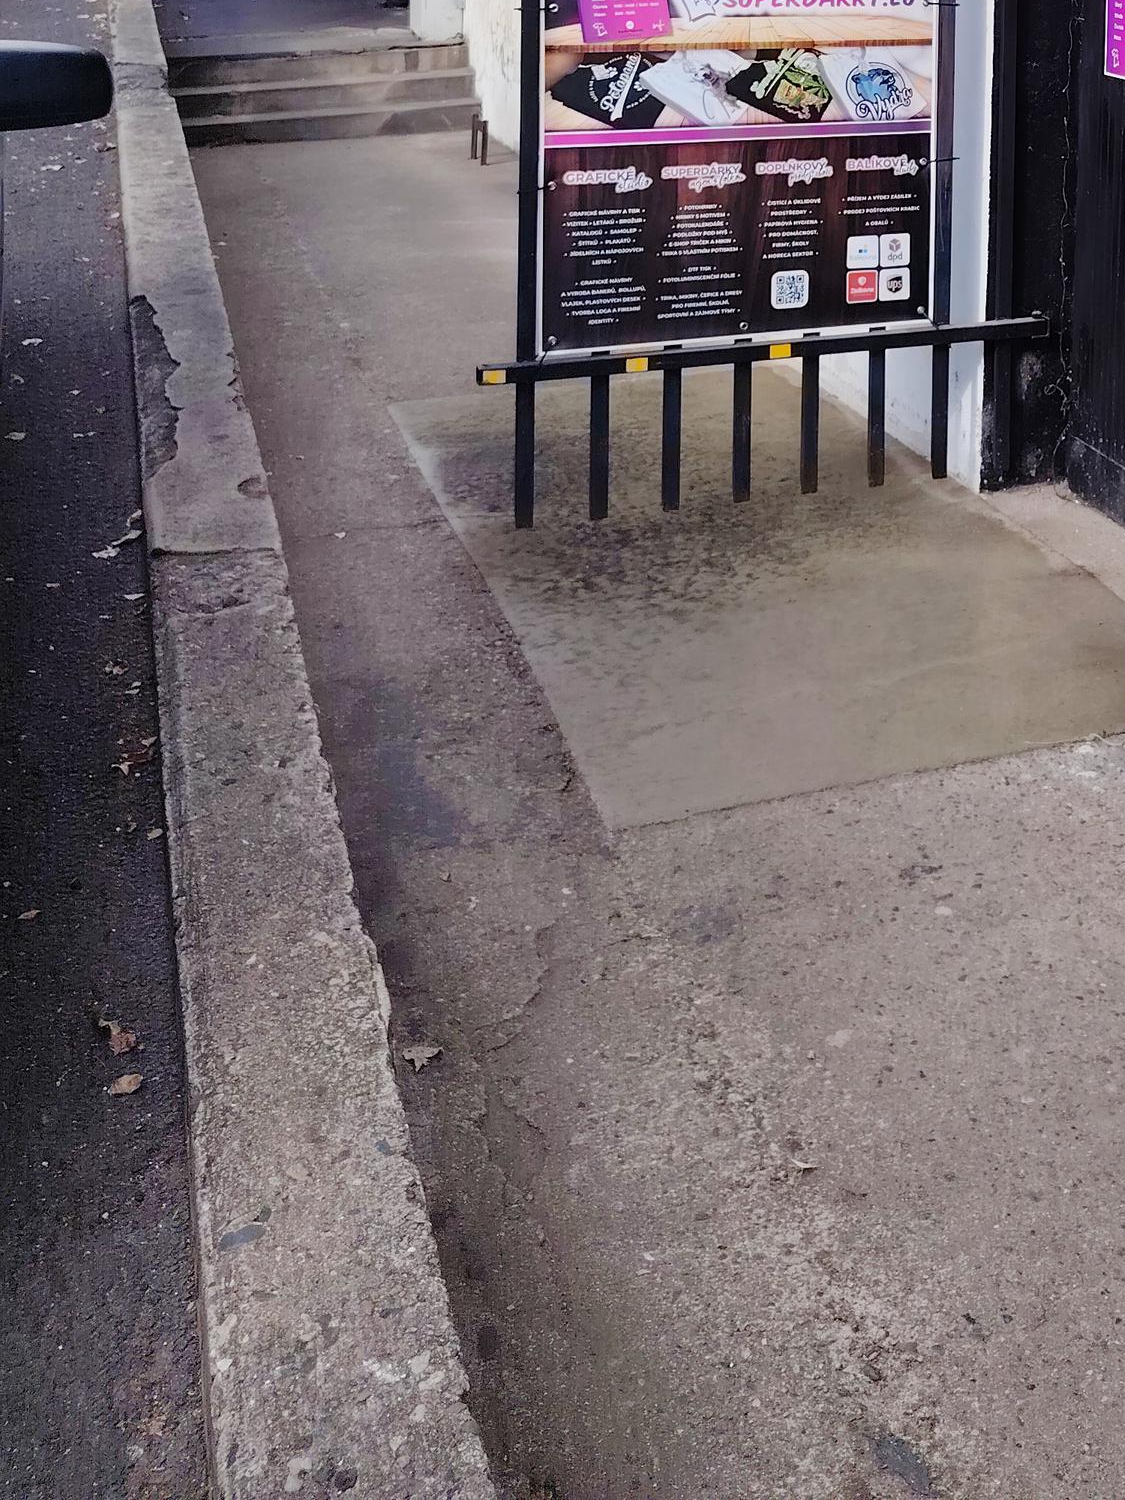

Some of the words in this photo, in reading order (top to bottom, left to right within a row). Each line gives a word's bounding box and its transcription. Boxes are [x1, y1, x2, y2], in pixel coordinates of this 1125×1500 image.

[758, 160, 826, 174] DOPLŇKOVÝ
[847, 155, 907, 170] BALÍKOVÉ
[565, 167, 635, 183] GRAFICKÉ
[663, 164, 740, 177] SUPERDÁRKY
[888, 252, 903, 263] dpd
[887, 280, 903, 291] ups
